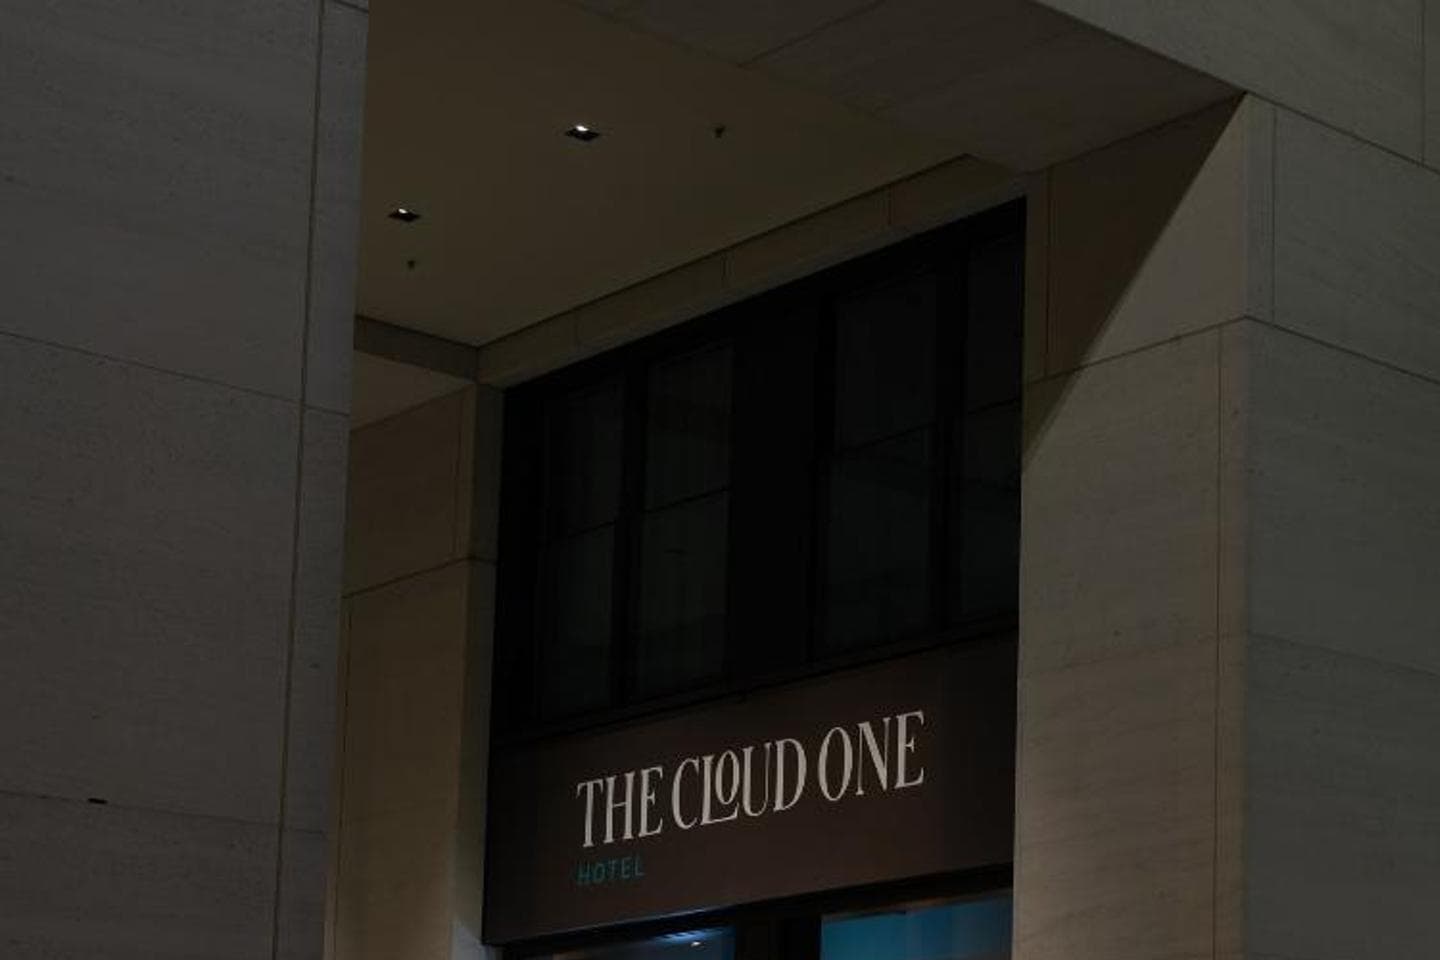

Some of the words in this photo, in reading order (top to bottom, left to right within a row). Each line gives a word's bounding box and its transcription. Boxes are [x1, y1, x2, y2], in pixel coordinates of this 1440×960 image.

[576, 766, 664, 848] THE
[671, 738, 808, 830] CLOUD
[817, 710, 926, 802] ONE
[576, 853, 646, 887] HOTEL
